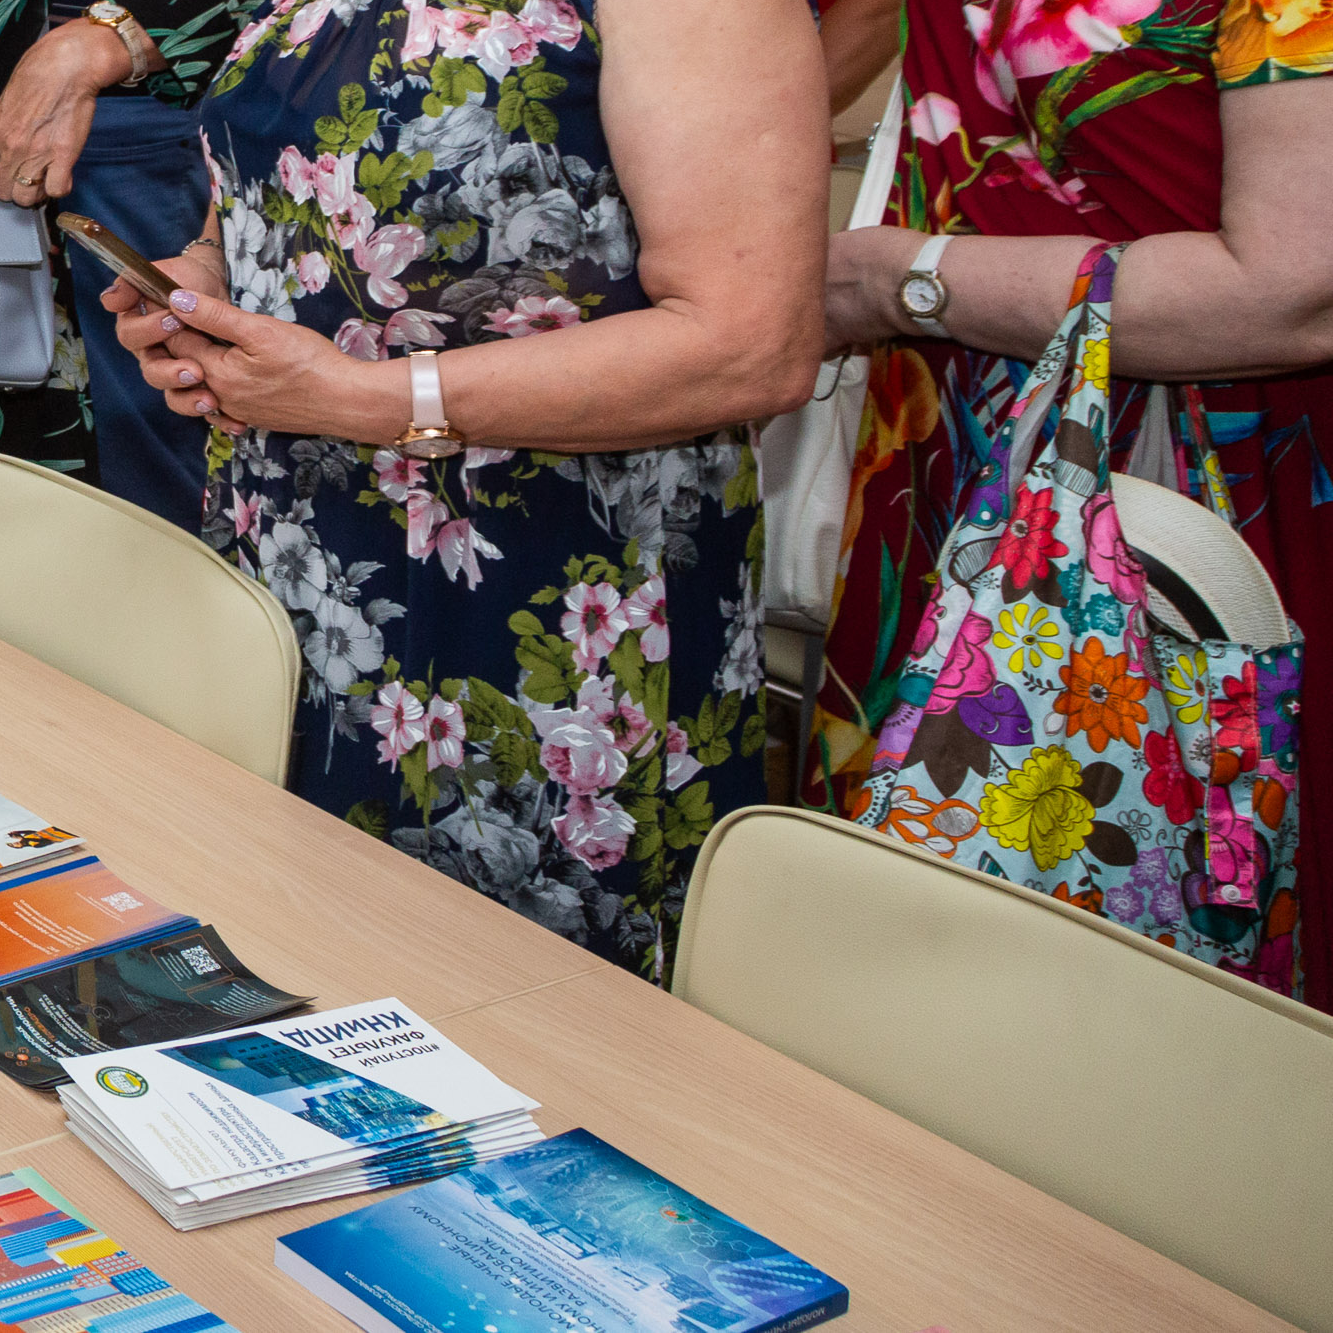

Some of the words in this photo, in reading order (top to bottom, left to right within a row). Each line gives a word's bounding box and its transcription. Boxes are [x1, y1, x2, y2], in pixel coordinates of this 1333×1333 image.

[3, 995, 53, 1047] ГЕОТЕХНОЛОГИЙ
[277, 1011, 412, 1048] КНиИПД
[323, 1029, 429, 1058] ФАКУЛЬТЕТ
[357, 1043, 442, 1068] #ПОСТУПАЙ
[203, 1081, 230, 1102] данных
[186, 1091, 233, 1133] недвижимости
[214, 1106, 271, 1156] инфраструктуры
[224, 1103, 289, 1159] пространственных
[205, 1129, 249, 1168] Факультет
[227, 1134, 262, 1165] Кадастра
[406, 1203, 545, 1292] ИННОВАЦИОННОМУ
[446, 1244, 506, 1280] УЧЕНЫЕ
[478, 1236, 512, 1256] АПК
[507, 1256, 588, 1305] РАЗВИТИЮ
[540, 1292, 558, 1301] И
[499, 1279, 577, 1329] МОЛОДЫЕ
